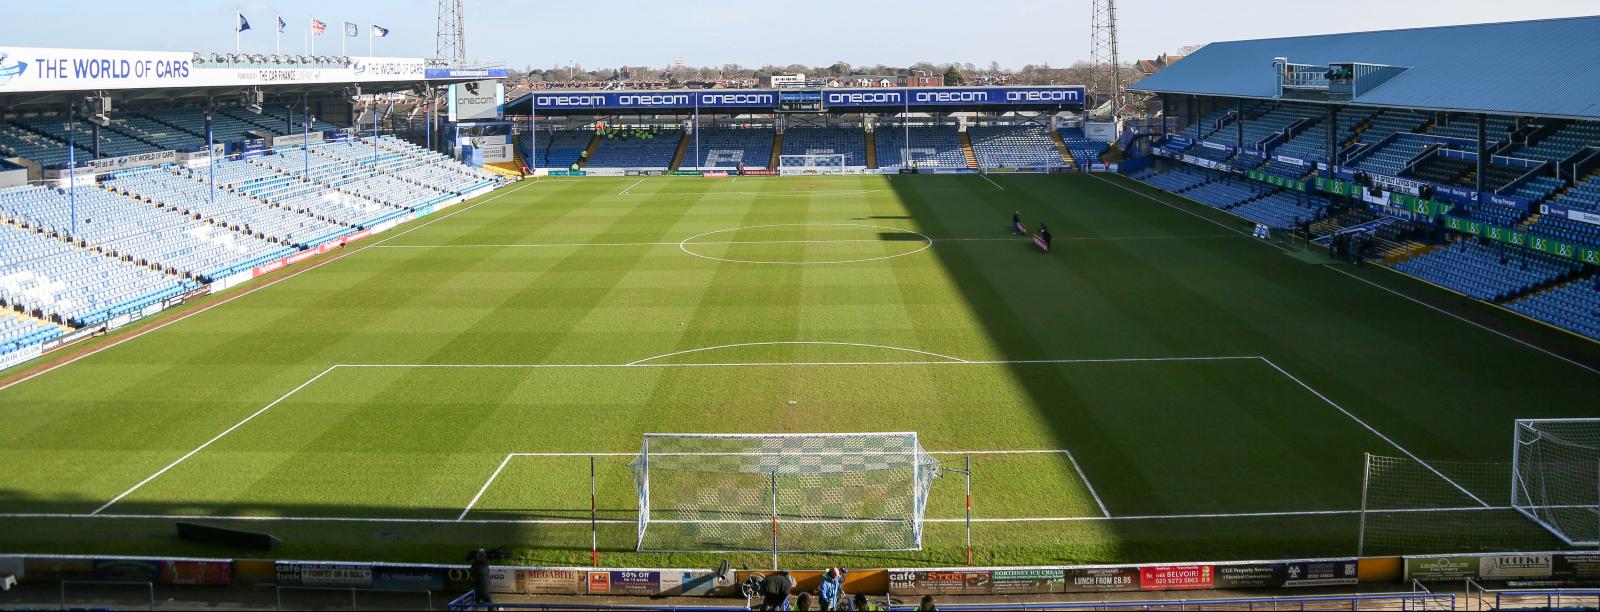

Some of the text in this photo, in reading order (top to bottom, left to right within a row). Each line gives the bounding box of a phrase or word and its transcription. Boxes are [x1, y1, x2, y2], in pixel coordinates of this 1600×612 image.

[36, 59, 189, 79] THE WORLD OF CARS
[368, 63, 423, 75] THE WORLD OF CARS
[259, 70, 267, 81] THE
[269, 70, 277, 81] CAR
[279, 70, 295, 81] FINANCE
[537, 95, 605, 106] onecom
[619, 95, 688, 105] onecom
[702, 94, 772, 104] onecom
[828, 93, 900, 103] onecom
[916, 91, 987, 102] onecom
[1006, 90, 1077, 101] onecom
[138, 154, 155, 162] WORLD
[162, 151, 174, 160] CARS
[1330, 180, 1344, 195] L&S
[1413, 199, 1430, 216] L&S
[1449, 218, 1461, 230] L&S
[1466, 222, 1481, 234] L&S
[1487, 226, 1501, 239] L&S
[1508, 231, 1523, 244] L&S
[1531, 236, 1547, 250] L&S
[1555, 242, 1571, 257] L&S
[1582, 248, 1600, 263] L&S
[528, 571, 575, 579] MEGABITE
[889, 571, 916, 589] café tusk
[1074, 576, 1131, 585] LUNCH FROM £8.95
